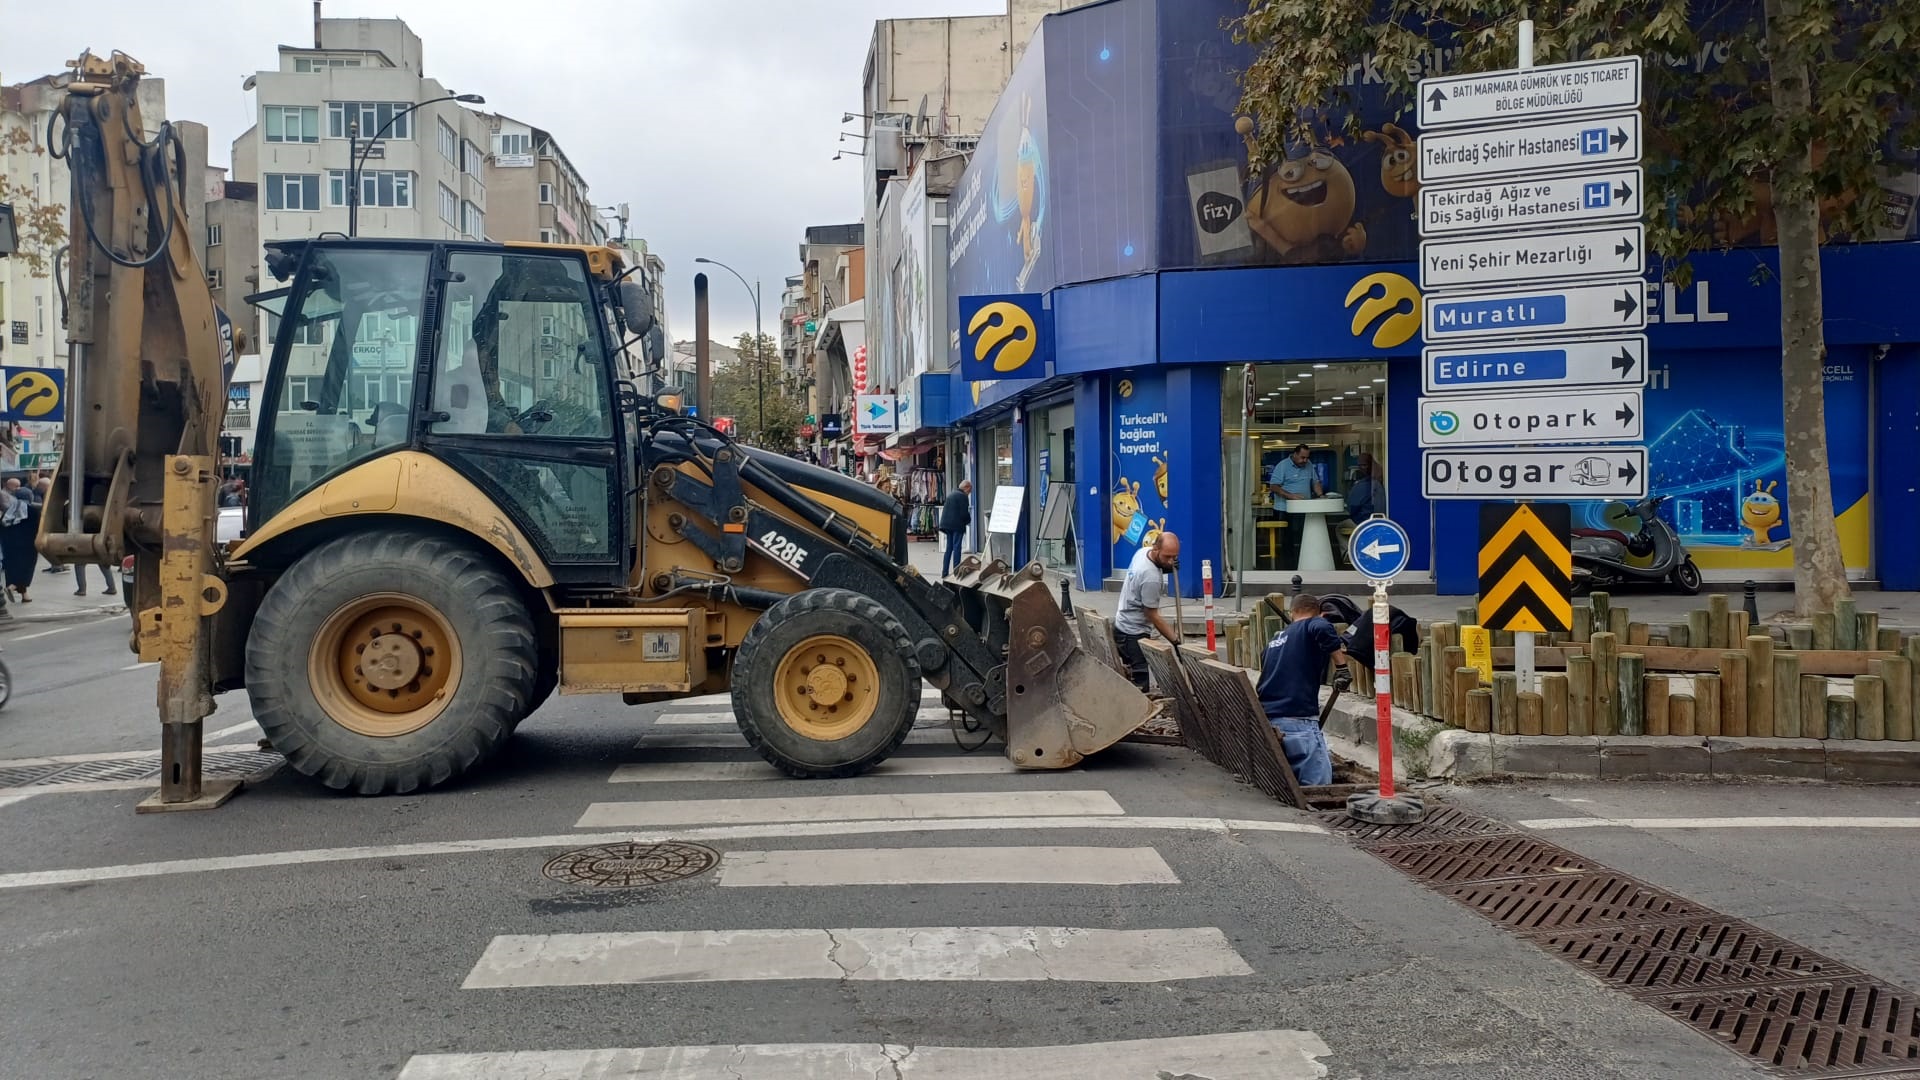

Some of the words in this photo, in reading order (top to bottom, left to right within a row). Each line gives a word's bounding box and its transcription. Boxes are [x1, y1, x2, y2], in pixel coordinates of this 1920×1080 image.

[1453, 85, 1472, 98] BATI
[1474, 80, 1518, 96] MARMARA
[1520, 73, 1559, 91] GÜMRÜK
[1561, 74, 1572, 86] VE
[1574, 72, 1589, 87] DIŞ
[1495, 96, 1524, 112] BÖLGE
[1526, 88, 1583, 108] MÜDÜRLÜĞÜ
[1427, 144, 1479, 166] Tekirdağ
[1482, 140, 1515, 163] Şehir
[1518, 133, 1580, 156] Hastanesi
[1586, 132, 1603, 153] H
[1430, 189, 1492, 207] Tekirdağ
[1500, 185, 1531, 202] Ağız
[1534, 186, 1551, 197] ve
[1588, 186, 1605, 206] H
[1430, 210, 1452, 225] Diş
[1455, 205, 1504, 223] Sağlığı
[1508, 198, 1580, 218] Hastanesi
[1430, 254, 1464, 272] Yeni
[1468, 250, 1511, 272] Şehir
[1516, 244, 1592, 265] Mezarlığı
[1439, 303, 1536, 327] Muratlı
[220, 323, 233, 365] CAT
[1439, 360, 1526, 379] Edirne
[1473, 409, 1597, 433] Otopark
[1120, 428, 1155, 442] bağlan
[1120, 442, 1160, 456] hayata!
[1430, 459, 1565, 490] Otogar
[760, 530, 809, 569] 428E
